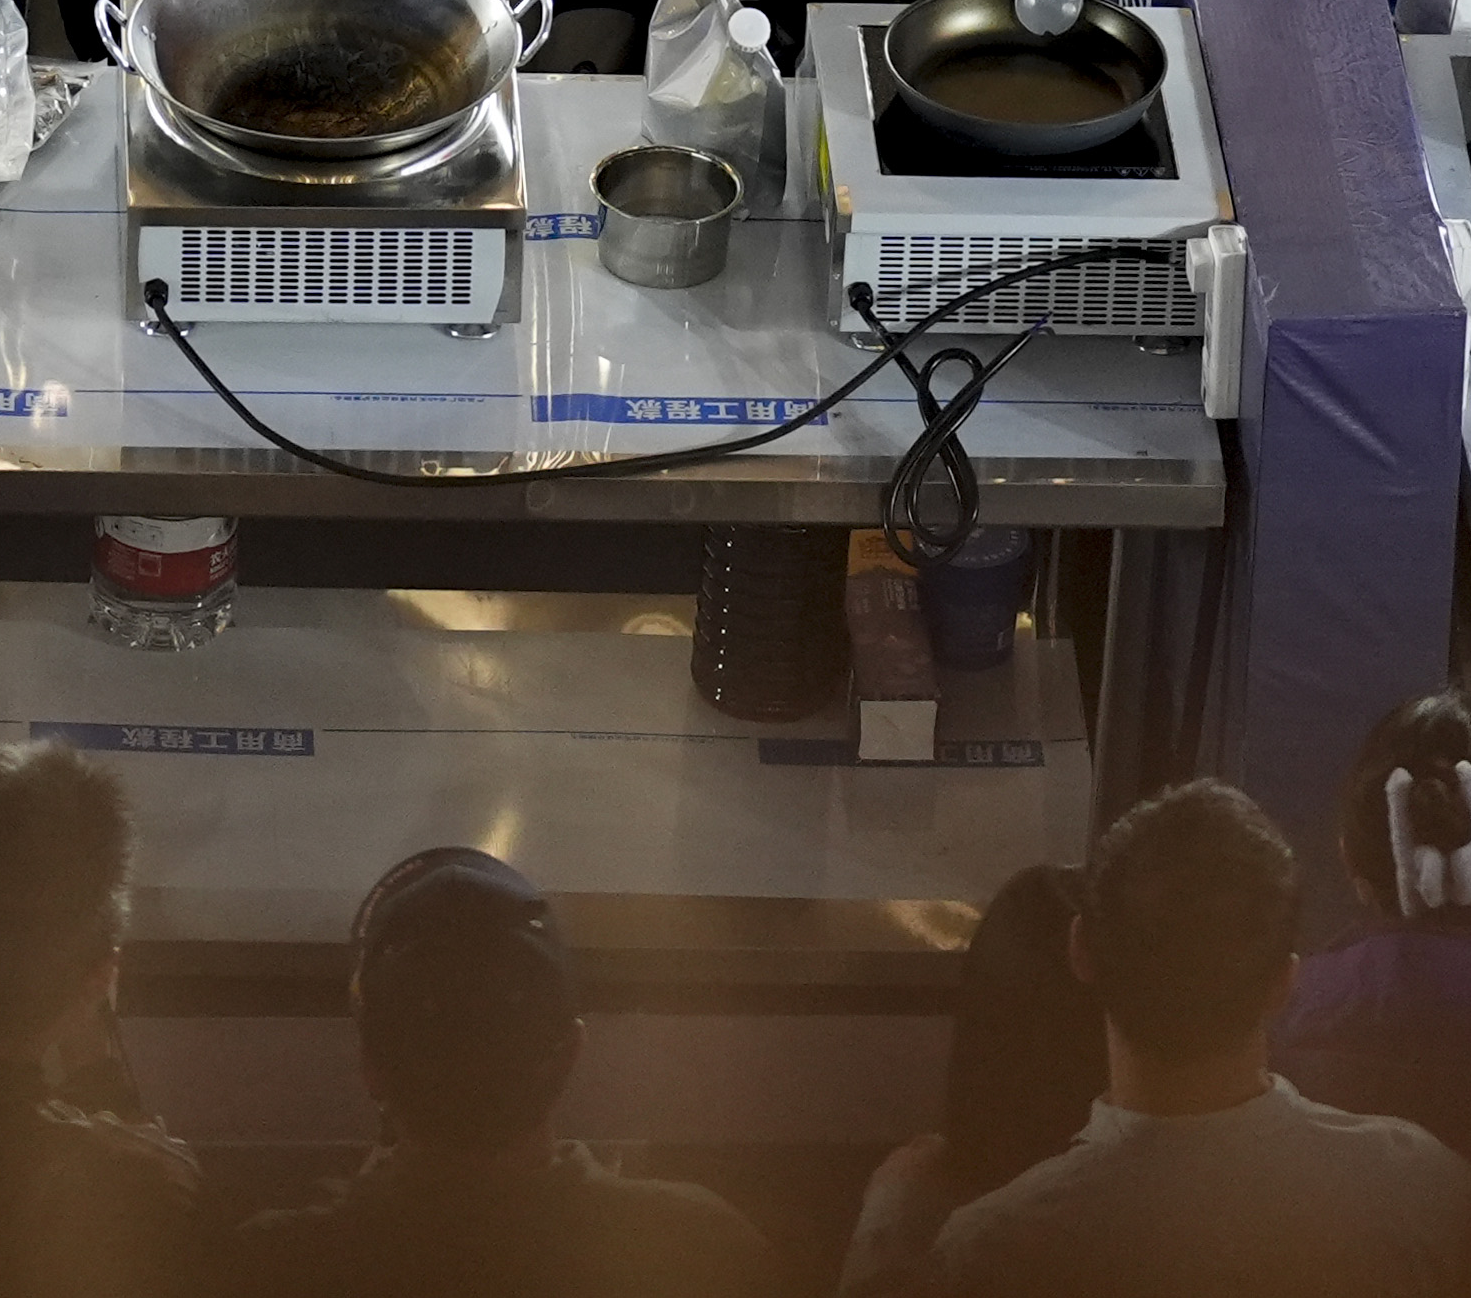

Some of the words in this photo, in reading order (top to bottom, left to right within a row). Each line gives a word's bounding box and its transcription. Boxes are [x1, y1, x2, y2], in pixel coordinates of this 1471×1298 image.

[122, 727, 306, 751] 商用工程款
